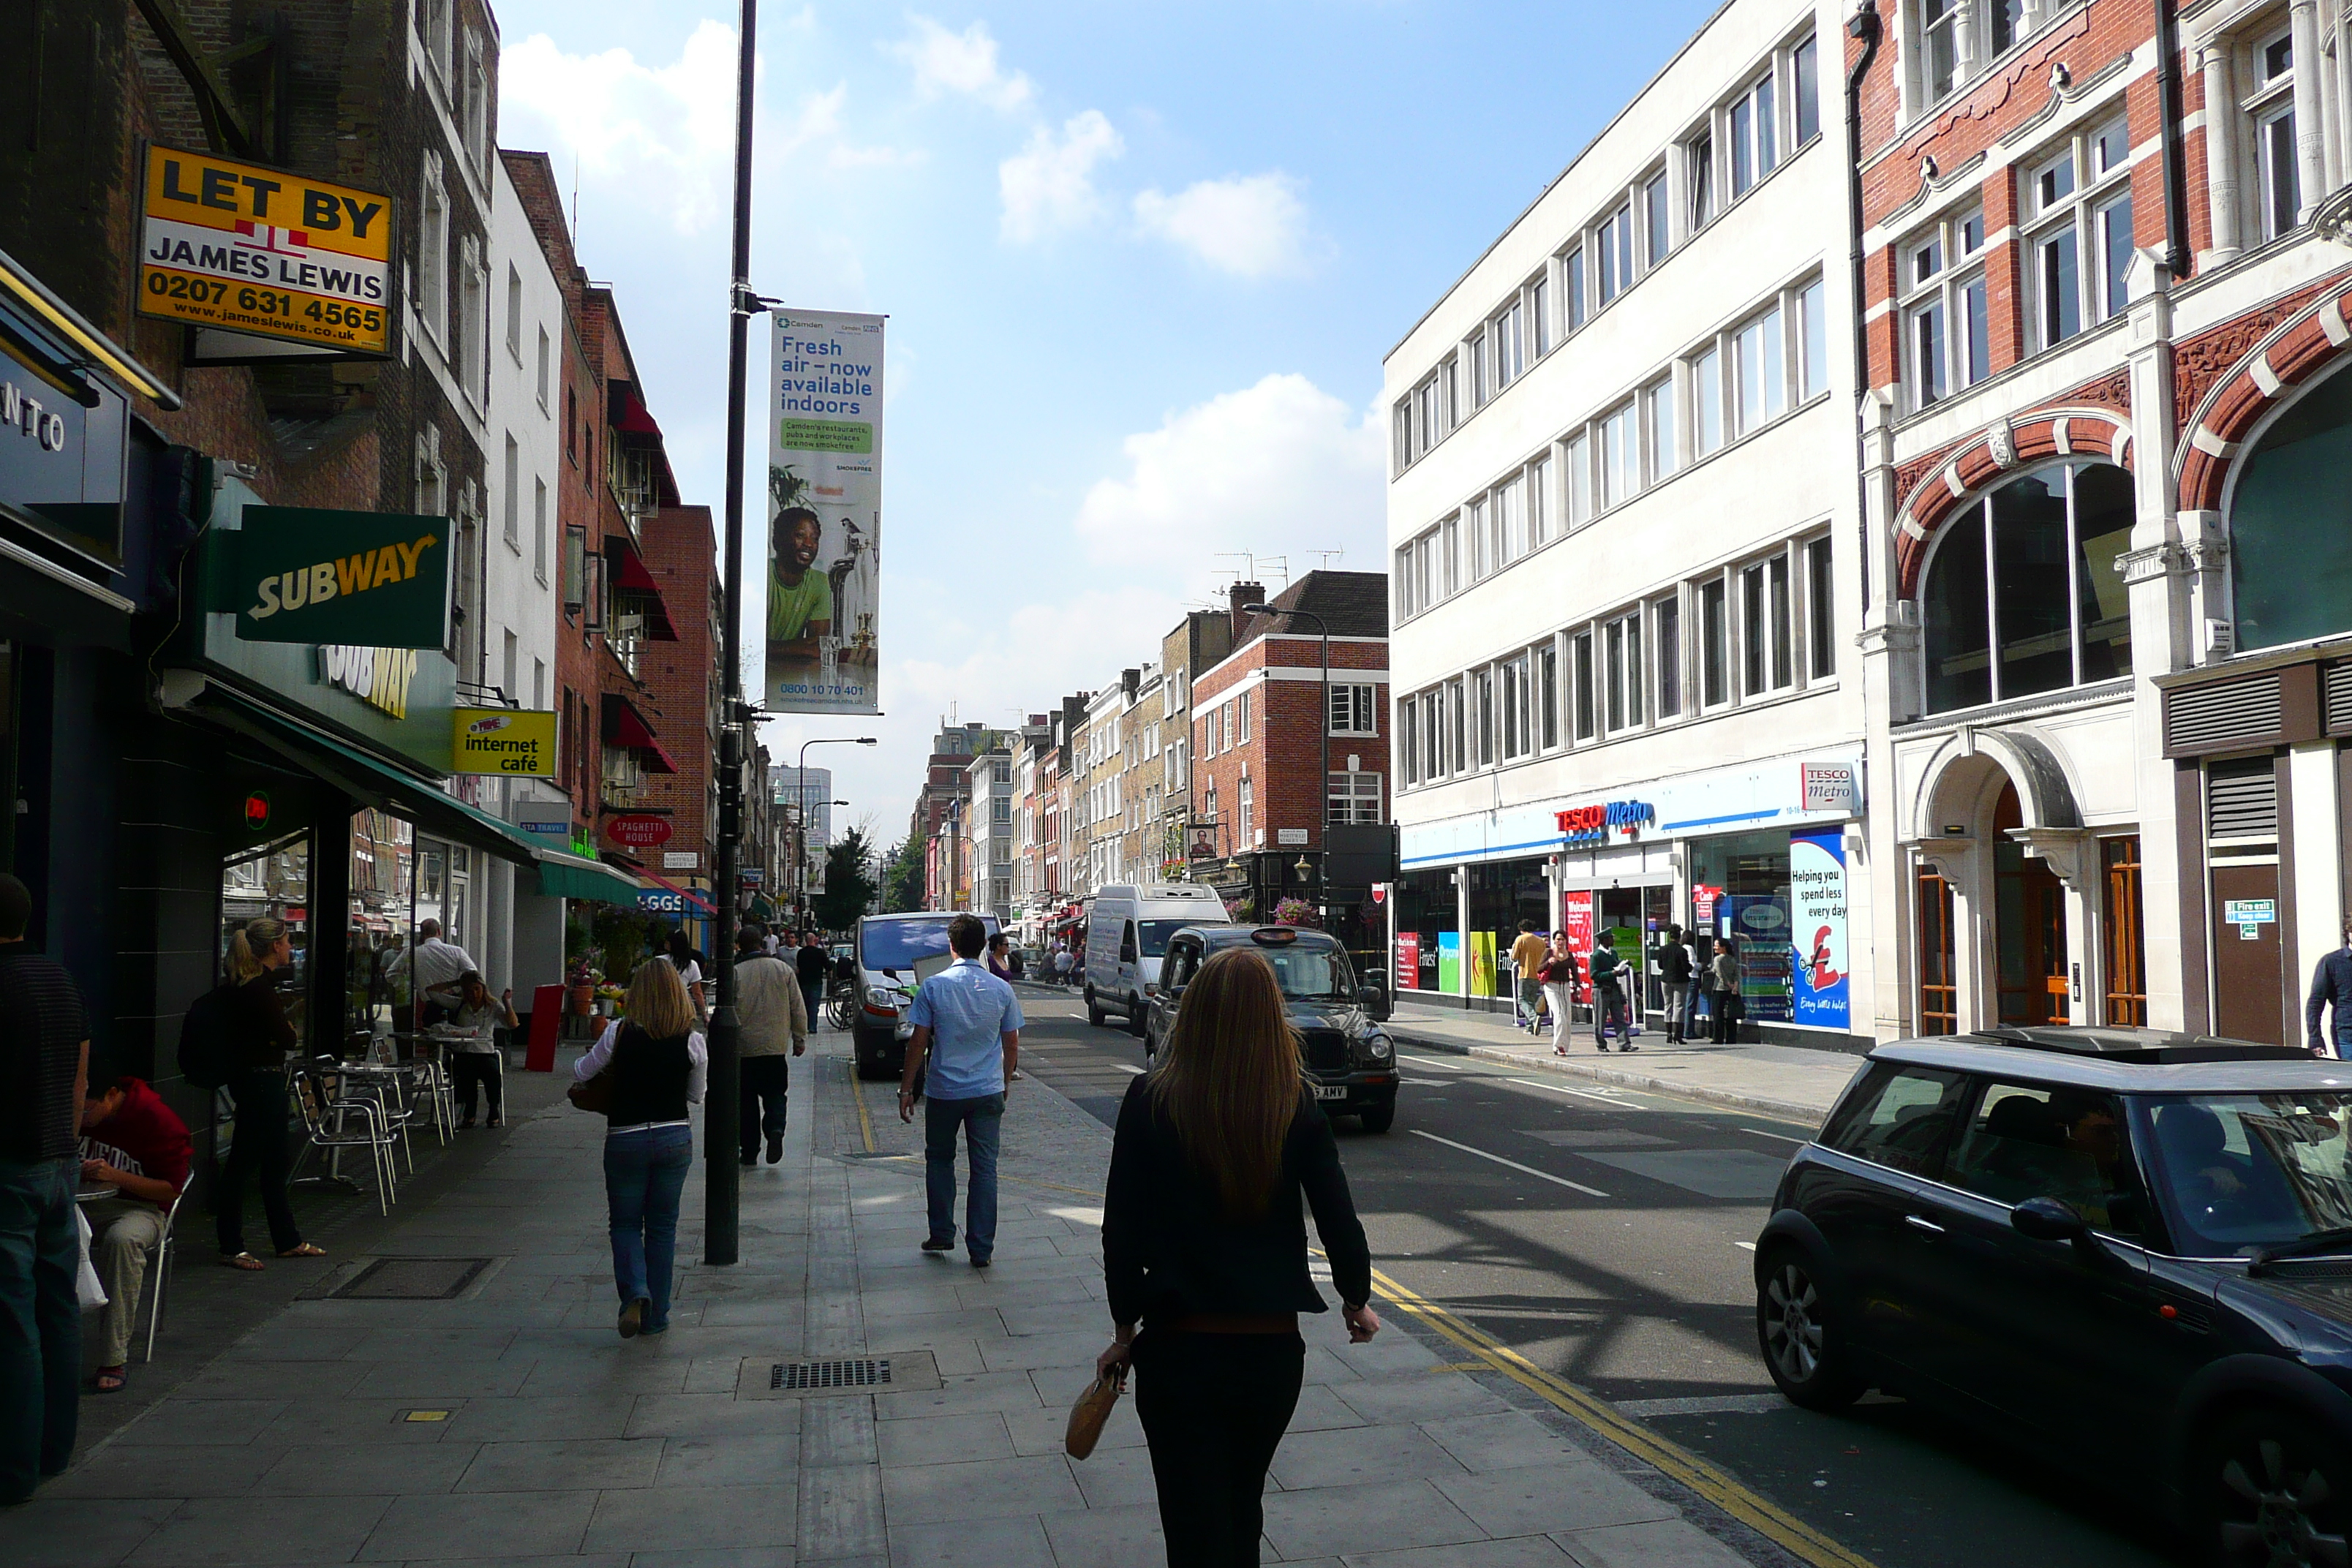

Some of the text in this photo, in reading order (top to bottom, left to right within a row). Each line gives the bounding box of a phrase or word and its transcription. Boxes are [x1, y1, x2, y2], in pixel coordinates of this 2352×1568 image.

[162, 159, 382, 239] LET BY
[150, 237, 382, 299] JAMES LEWIS
[148, 272, 380, 331] 0207 631 4565
[174, 303, 355, 341] www.jameslewis.co.uk
[791, 320, 823, 328] Camden
[782, 336, 842, 355] Fresh
[781, 355, 810, 372] air
[830, 362, 872, 377] now
[781, 377, 872, 396] available
[781, 393, 860, 415] indoors
[786, 431, 804, 440] pubs
[820, 433, 860, 442] workplaces
[816, 441, 854, 450] smokefree
[248, 532, 438, 622] SUBWAY
[780, 683, 863, 696] 0800 10 70 401
[466, 734, 538, 753] internet
[500, 755, 538, 772] café
[1808, 770, 1849, 779] TESCO
[1809, 785, 1850, 797] Metro
[1554, 801, 1650, 832] TESCO Metro
[617, 822, 663, 832] SPAGHETTI
[625, 833, 654, 842] HOUSE
[1793, 869, 1839, 885] Helping you
[637, 894, 682, 912] GGS
[1801, 886, 1842, 903] spend less
[1809, 903, 1847, 919] every day
[2237, 902, 2253, 911] Fire
[1439, 943, 1459, 962] Organi
[1801, 996, 1816, 1013] Every
[1324, 1087, 1343, 1097] AMV
